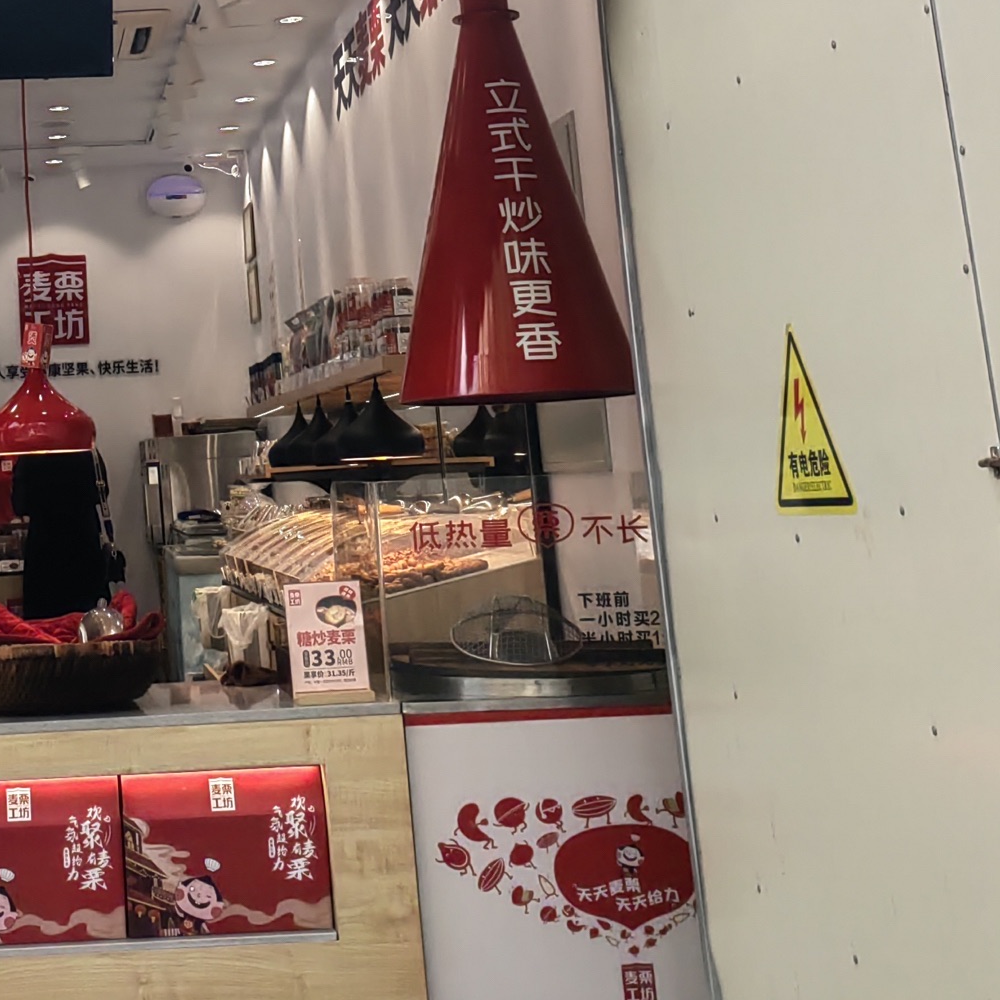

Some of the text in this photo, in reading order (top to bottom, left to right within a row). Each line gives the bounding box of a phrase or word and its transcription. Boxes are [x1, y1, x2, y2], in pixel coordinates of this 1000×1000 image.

[484, 78, 562, 361] 立式干炒味更香
[21, 270, 84, 302] 麦栗
[788, 449, 831, 479] 有电危险
[410, 518, 512, 551] 低热量
[581, 514, 649, 545] 不长
[577, 591, 630, 609] 下班前
[579, 610, 661, 628] 一小时买2
[8, 807, 30, 819] 工坊
[212, 797, 234, 809] 工坊
[616, 887, 680, 912] 天天给力
[625, 970, 653, 985] 麦栗
